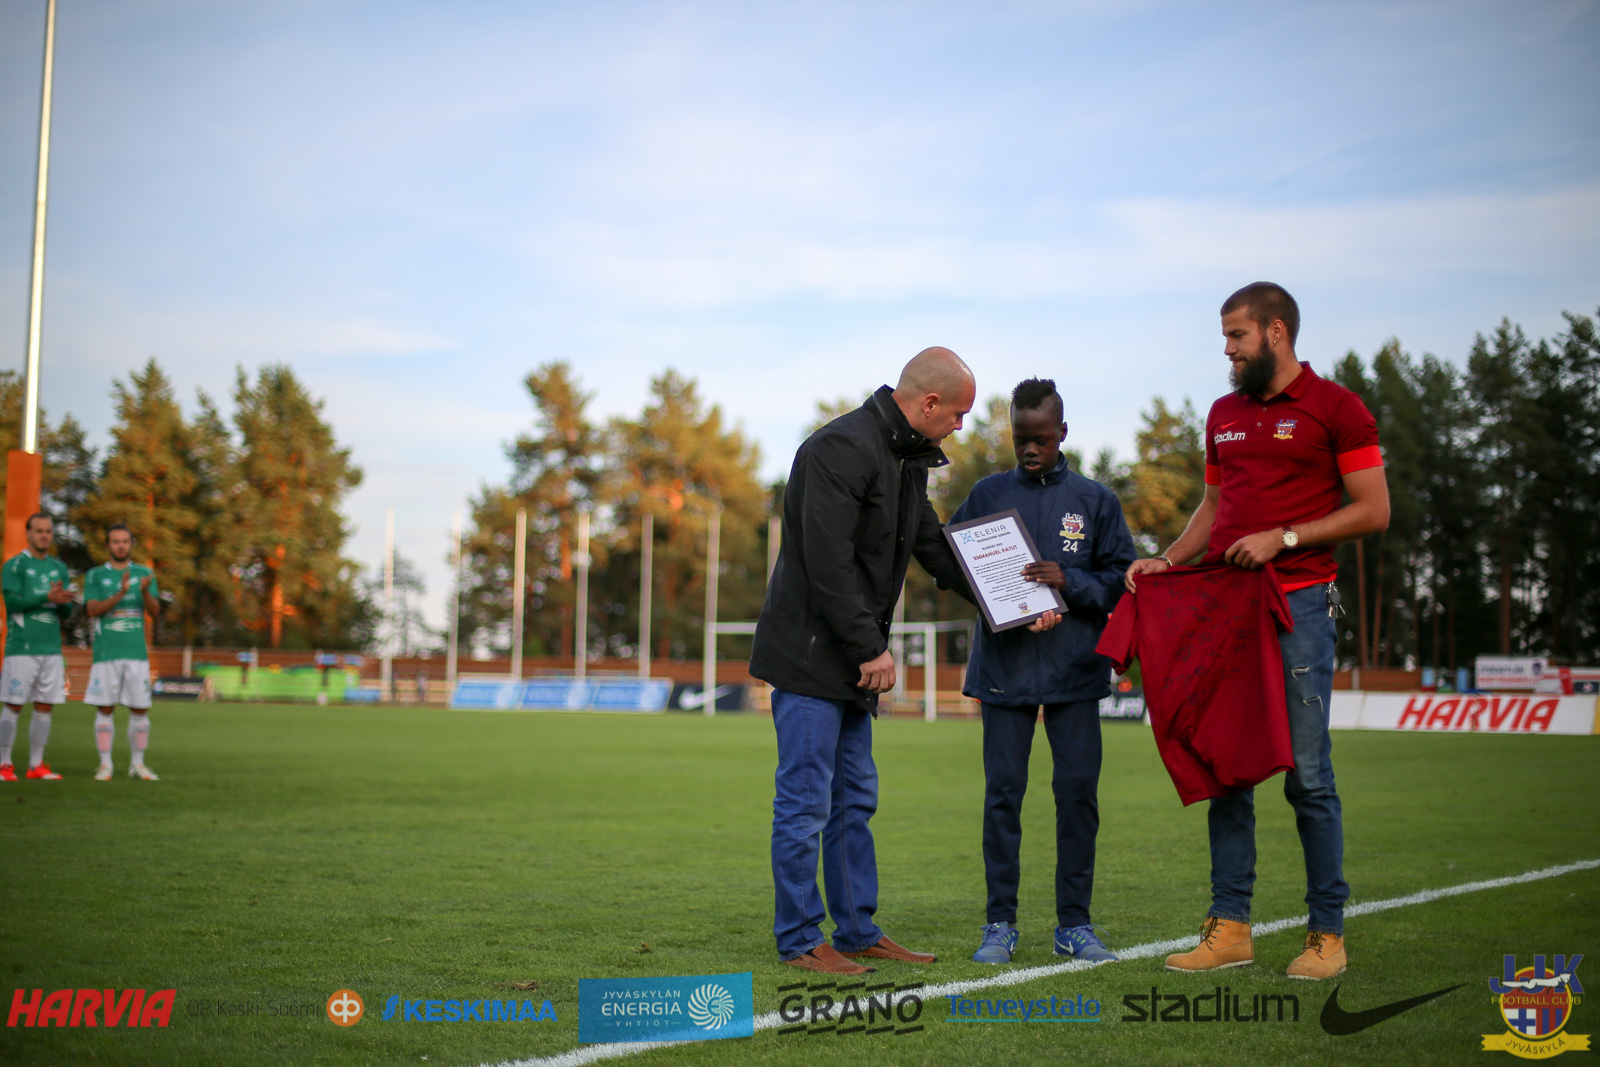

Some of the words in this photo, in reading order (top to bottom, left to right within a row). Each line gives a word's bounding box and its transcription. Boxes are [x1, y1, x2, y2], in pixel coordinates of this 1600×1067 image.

[1214, 431, 1246, 445] stadium
[974, 524, 1007, 538] ELENIA
[1062, 539, 1079, 553] 24
[973, 550, 1001, 561] EMMANUEL
[1397, 696, 1560, 734] HARVIA
